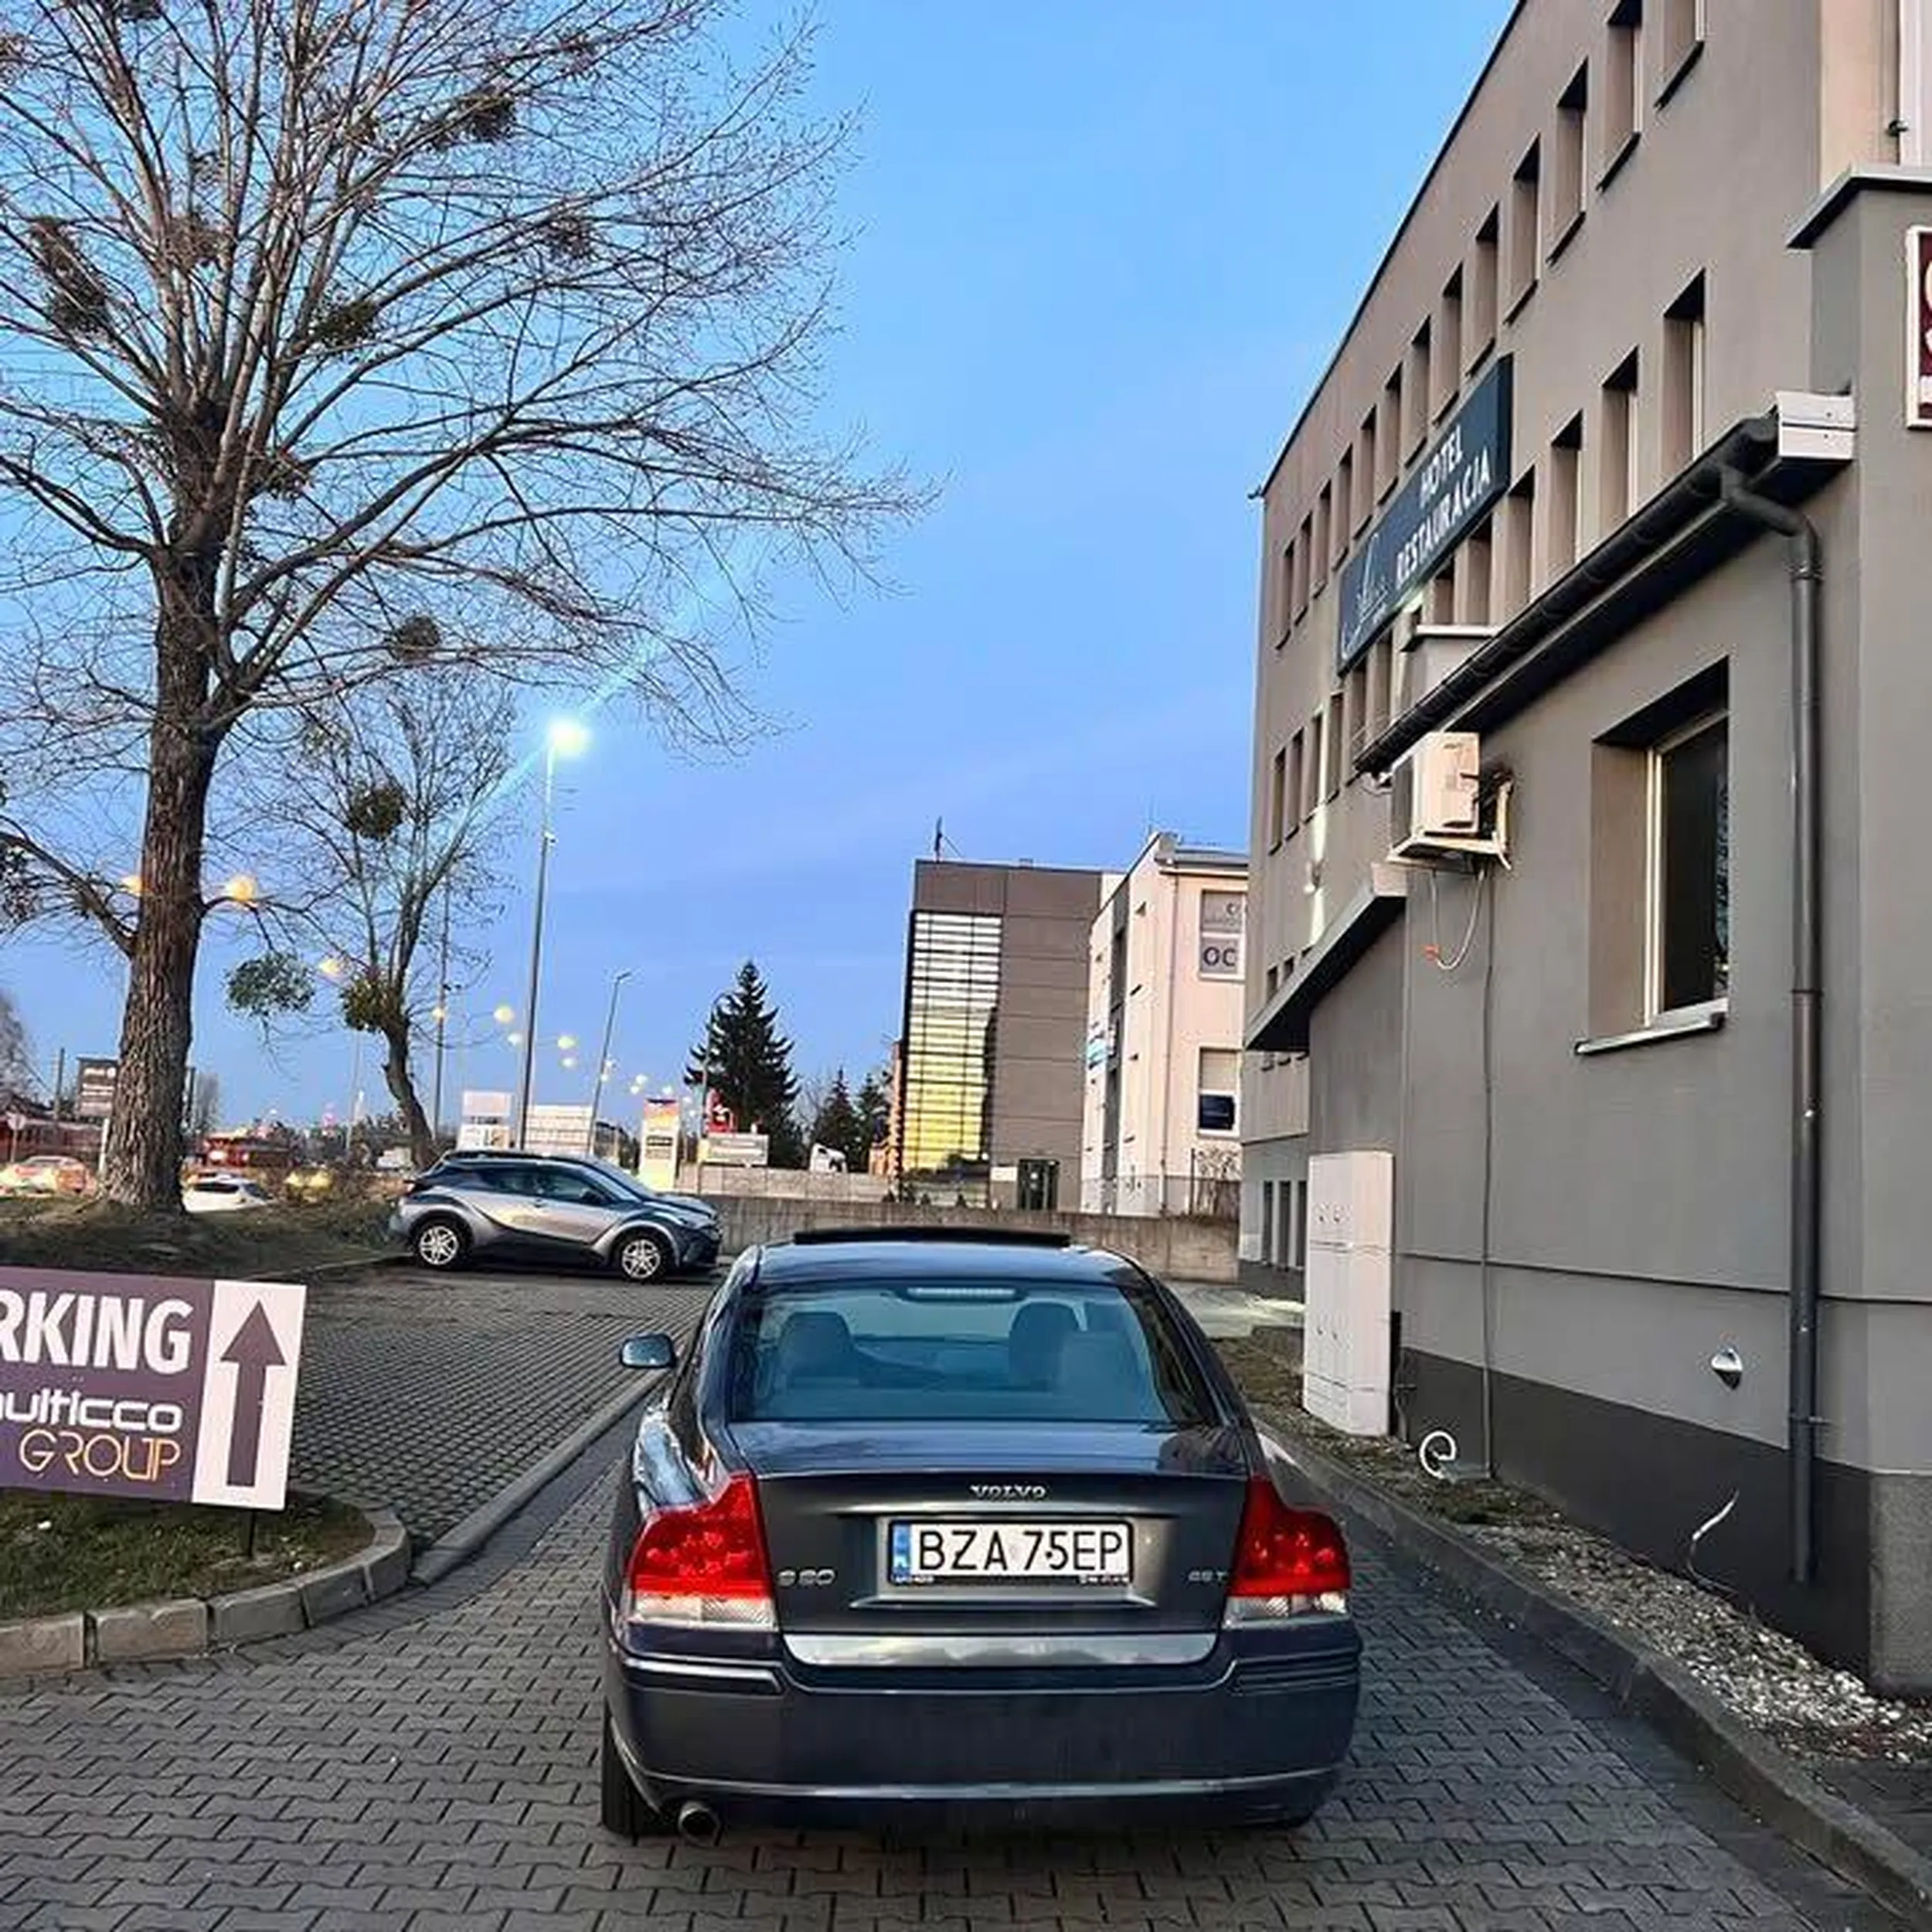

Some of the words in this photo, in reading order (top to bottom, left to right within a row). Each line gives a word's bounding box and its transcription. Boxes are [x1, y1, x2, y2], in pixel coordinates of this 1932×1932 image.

[1419, 423, 1463, 510] HOTEL
[1395, 445, 1491, 590] RESTAURACJA
[0, 1388, 184, 1434] ulticco
[19, 1428, 182, 1482] GROUP
[970, 1484, 1046, 1499] VOLVO
[919, 1530, 1008, 1571] BZA
[1022, 1530, 1122, 1571] 75EP
